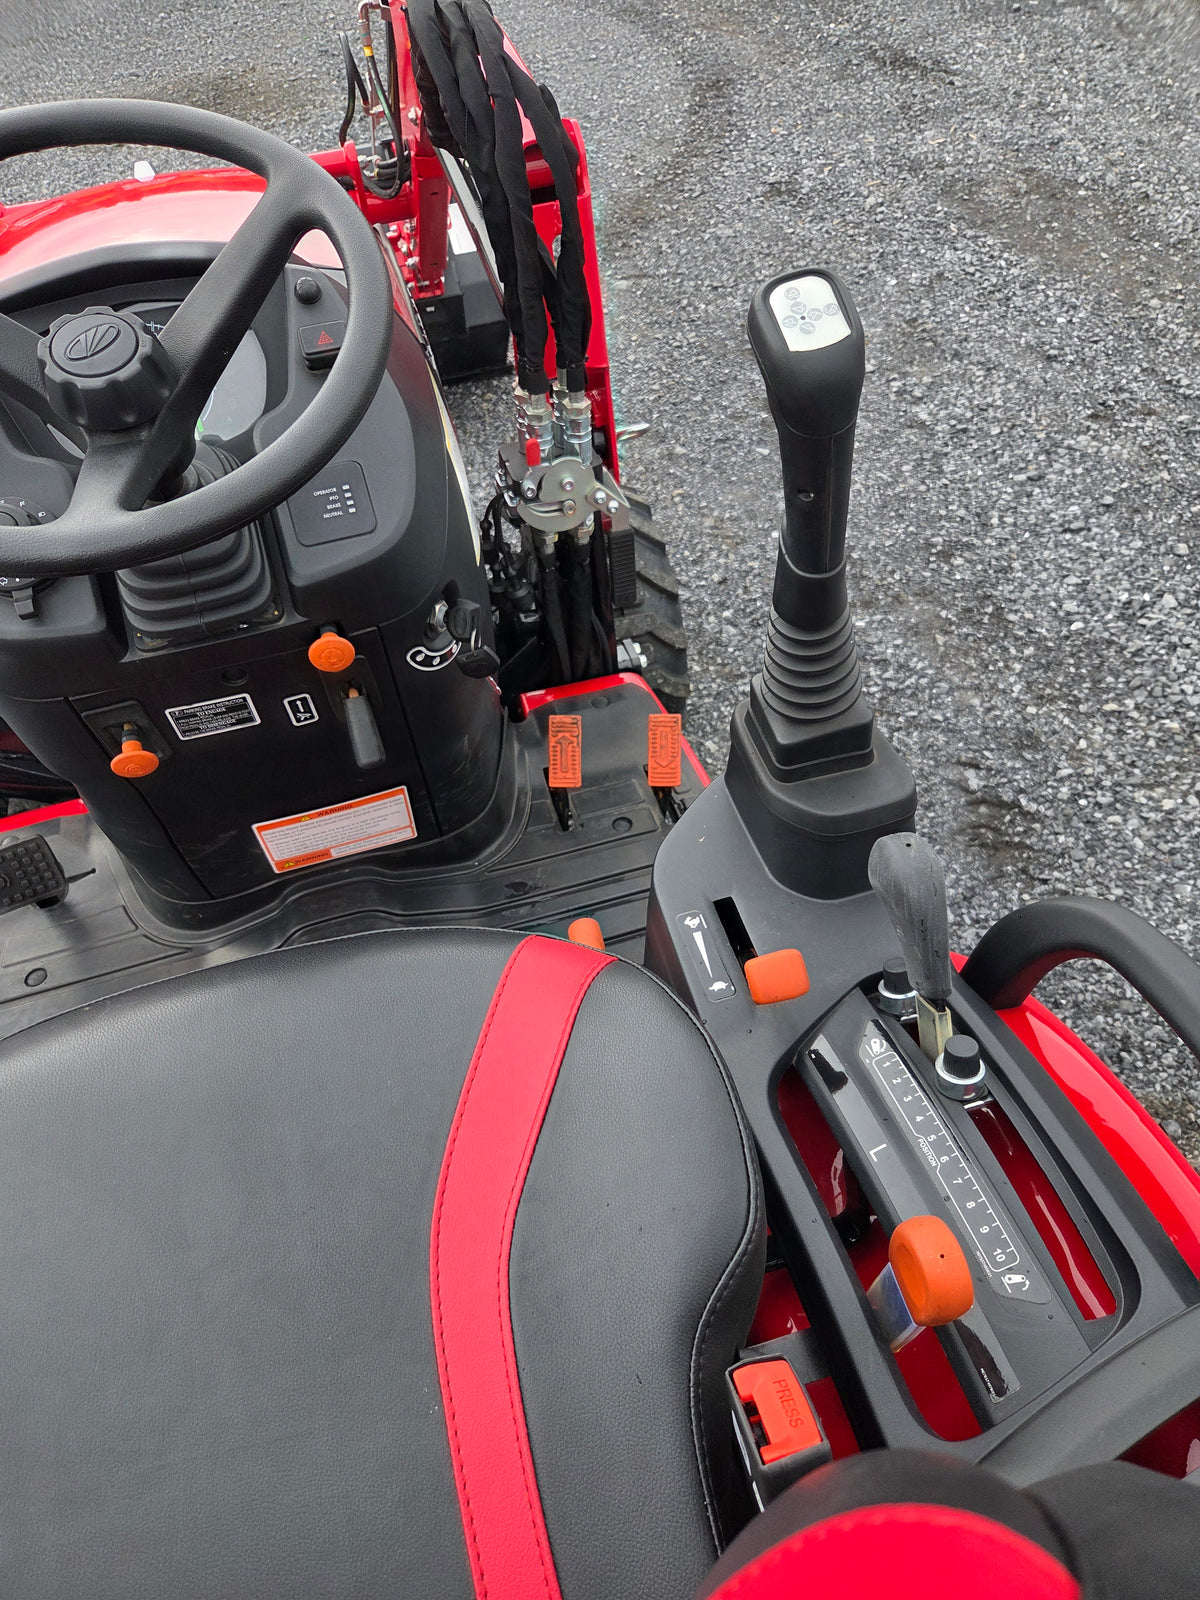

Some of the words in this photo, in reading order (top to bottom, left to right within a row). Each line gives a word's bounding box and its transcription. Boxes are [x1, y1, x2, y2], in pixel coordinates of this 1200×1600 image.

[313, 488, 336, 496] OPERATOR
[216, 698, 244, 707] INSTRUCTION
[316, 804, 353, 817] WARNING
[295, 852, 329, 864] WARNING
[869, 1143, 887, 1162] L
[918, 1138, 937, 1167] POSITION
[927, 1134, 936, 1142] 5
[940, 1155, 949, 1163] 6
[966, 1201, 975, 1209] 8
[979, 1225, 989, 1233] 9
[993, 1248, 1005, 1262] 10
[772, 1378, 804, 1429] PRESS
